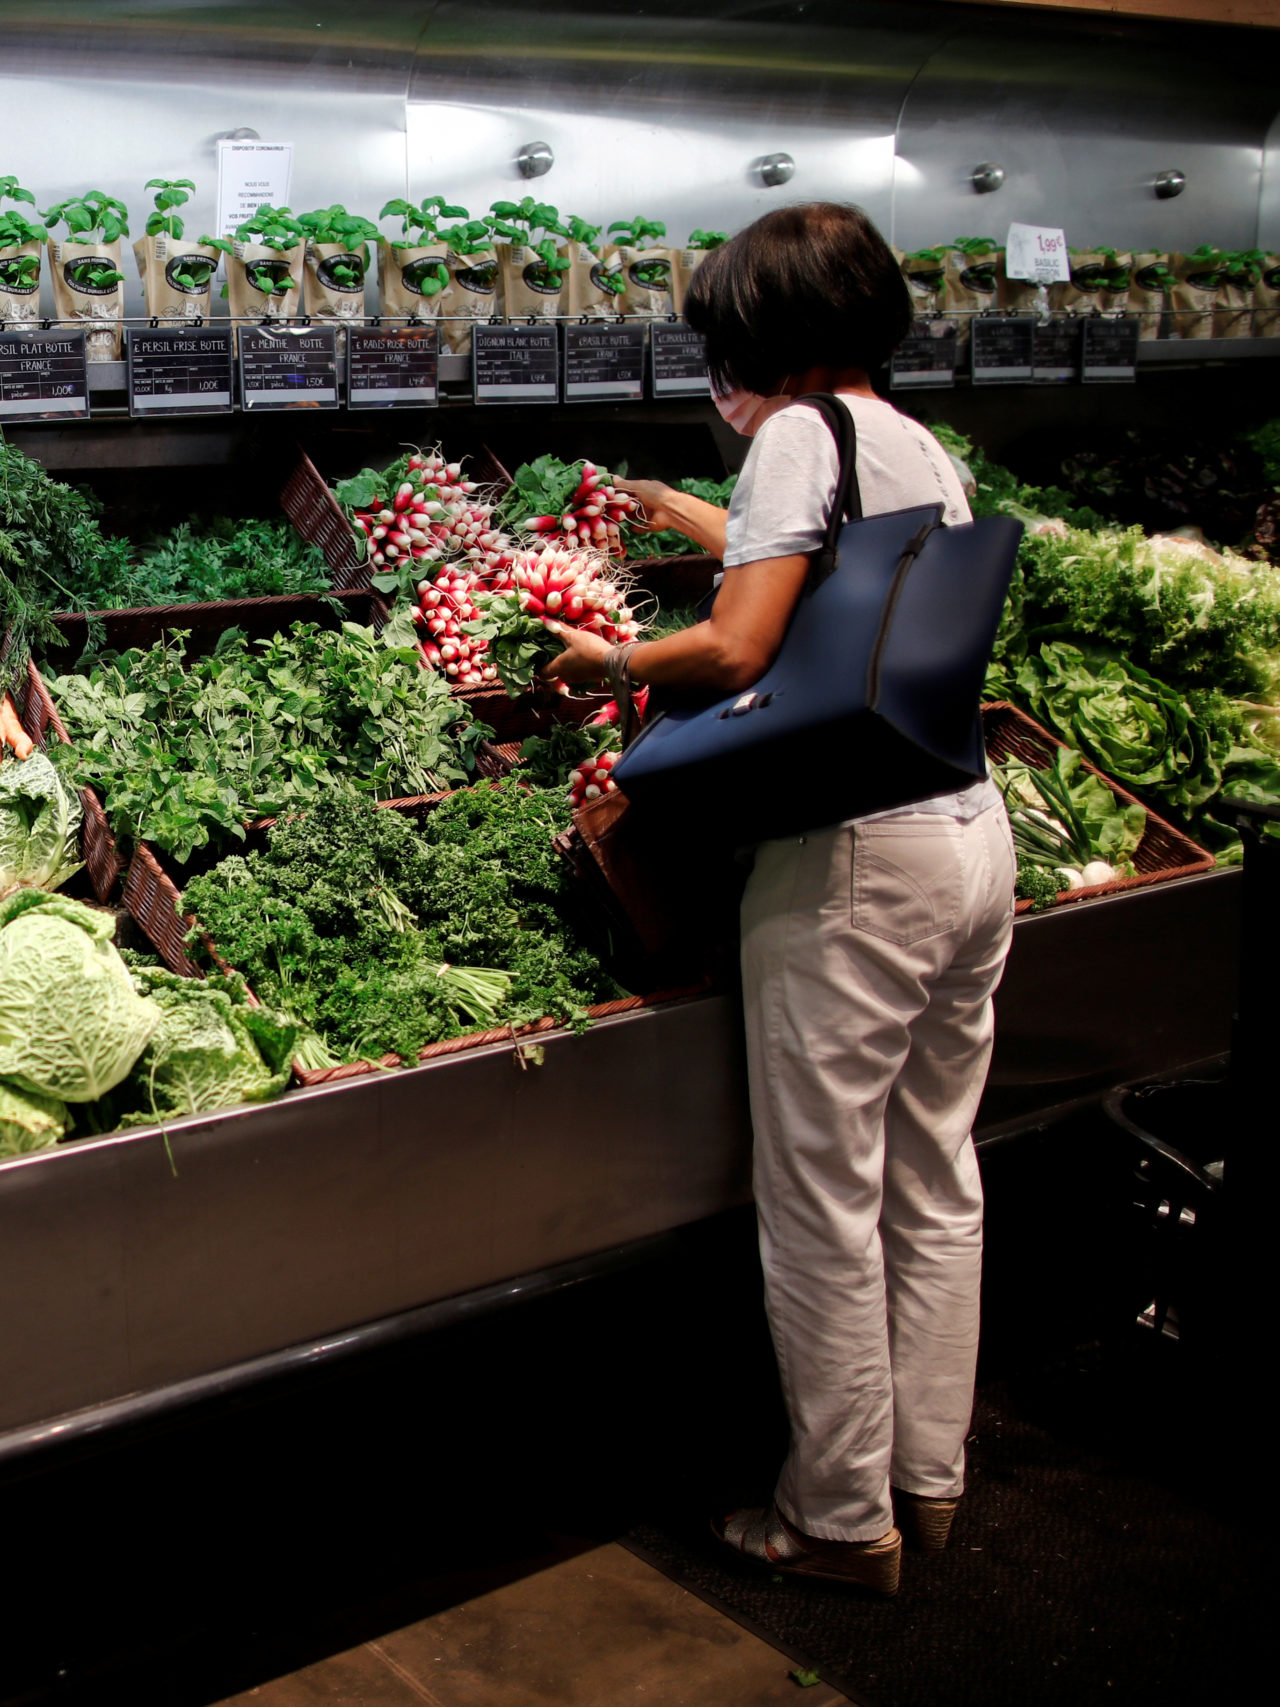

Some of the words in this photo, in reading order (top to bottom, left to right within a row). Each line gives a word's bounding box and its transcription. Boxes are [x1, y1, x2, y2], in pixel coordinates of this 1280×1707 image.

[1037, 234, 1063, 254] 1,99€
[1034, 258, 1059, 267] BASILIC
[142, 341, 172, 353] PERSIL
[173, 340, 198, 352] FRISE
[200, 339, 227, 351] BOTTE
[258, 339, 289, 349] MENTHE
[299, 338, 325, 349] BOTTE
[363, 339, 385, 349] RADIS
[387, 338, 405, 349] ROSE
[407, 338, 430, 349] BOTTE
[478, 337, 506, 347] OIGNON
[20, 343, 42, 354] PLAT
[45, 342, 74, 353] BOTTE
[279, 353, 307, 363] FRANCE
[384, 353, 410, 363] FRANCE
[20, 360, 53, 371] FRANCE
